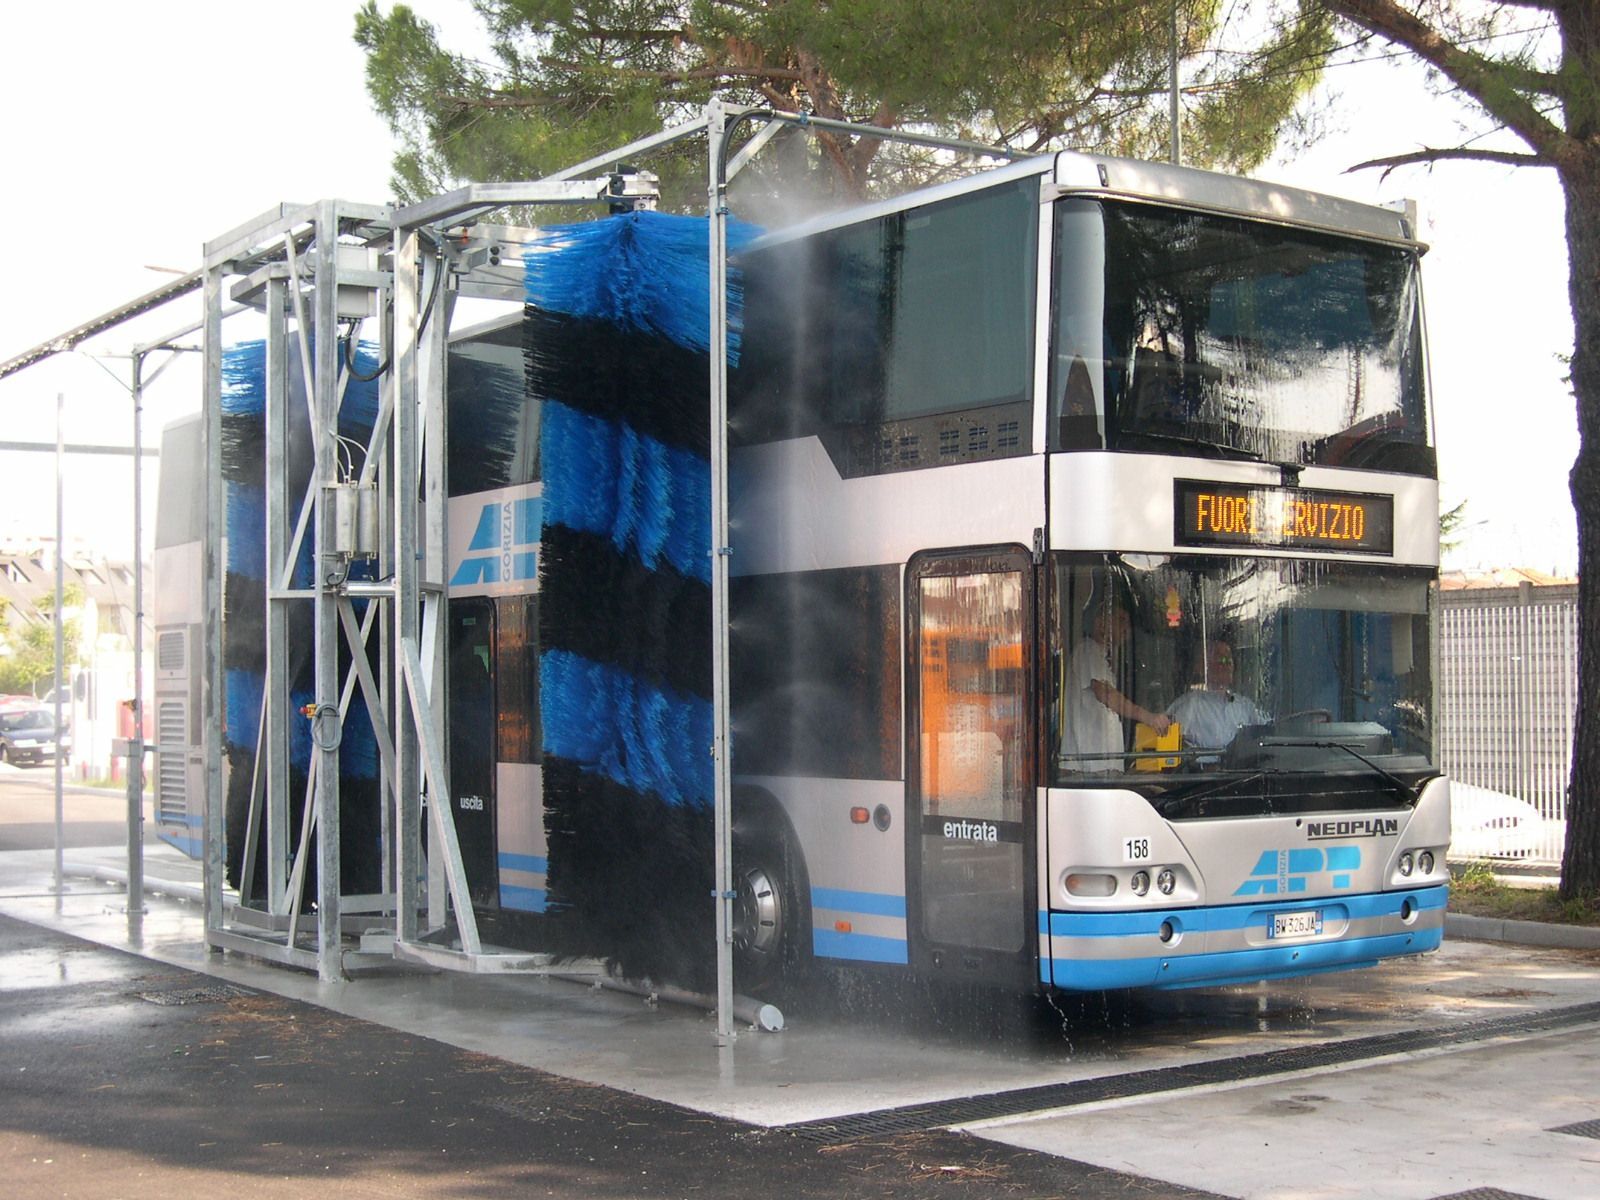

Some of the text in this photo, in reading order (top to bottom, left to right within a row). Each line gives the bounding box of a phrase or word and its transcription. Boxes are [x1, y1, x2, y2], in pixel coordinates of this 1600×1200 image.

[1197, 494, 1364, 540] FUORI ERVIZIO
[503, 501, 512, 582] GORIZIA
[460, 795, 484, 811] uscita
[943, 820, 998, 842] entrata
[1307, 818, 1398, 838] NEOPLAN
[1126, 839, 1149, 859] 158
[1279, 849, 1288, 894] GORIZIA
